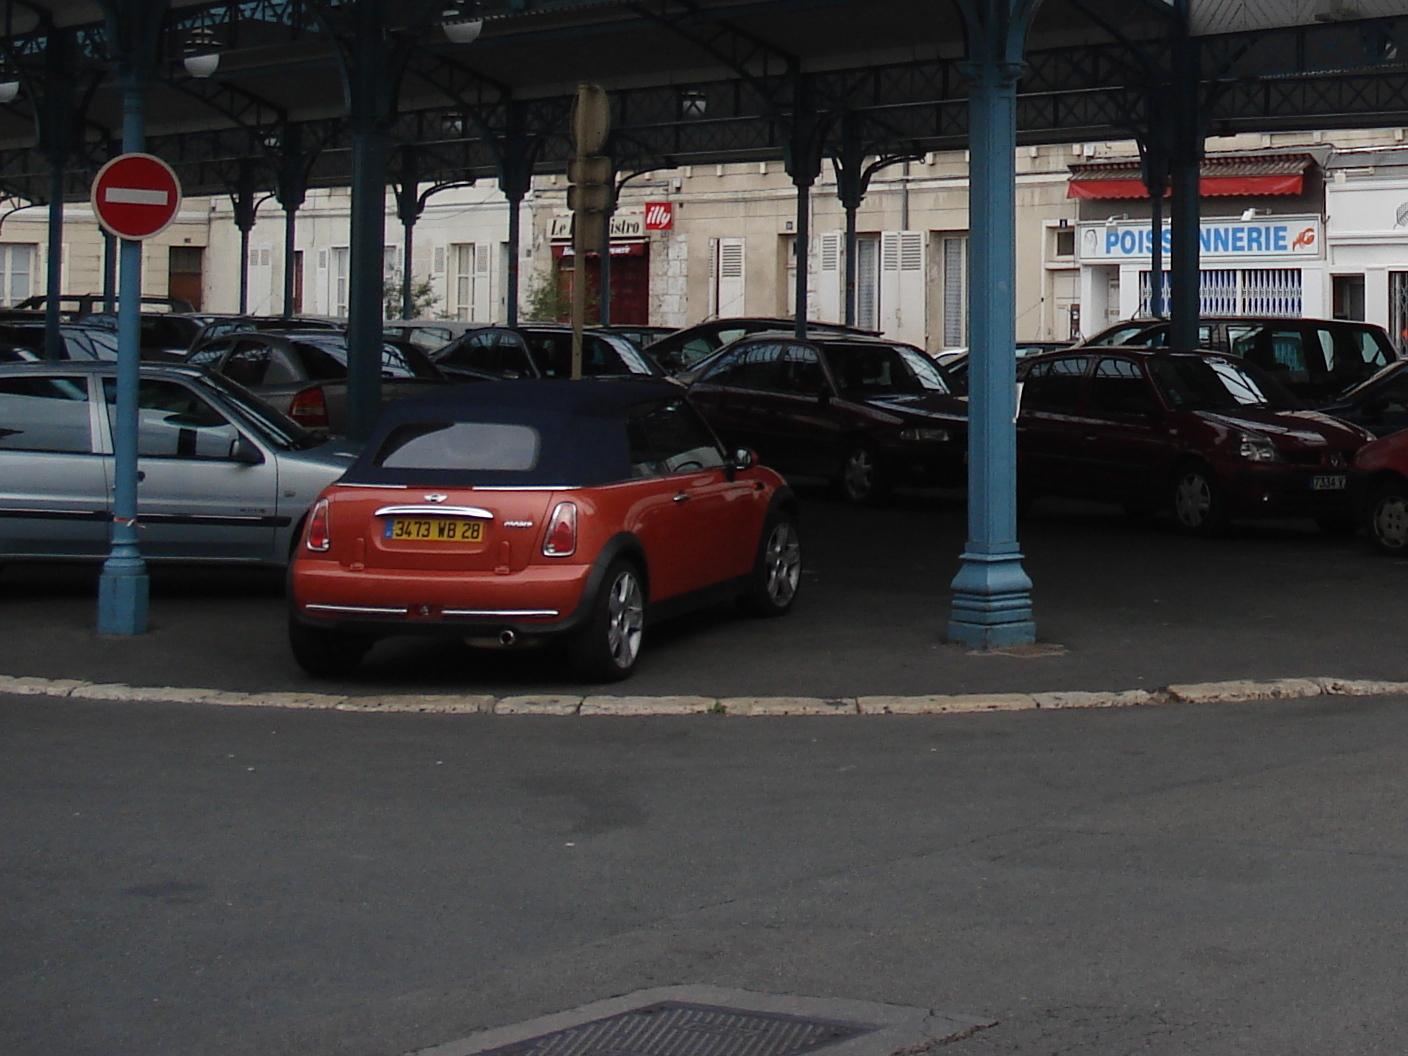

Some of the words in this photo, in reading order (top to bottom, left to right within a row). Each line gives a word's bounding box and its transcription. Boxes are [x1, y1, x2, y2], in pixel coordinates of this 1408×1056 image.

[550, 219, 566, 236] Le
[646, 205, 671, 229] illy
[1105, 226, 1288, 255] POISSNNERIE
[395, 521, 431, 538] 3473
[437, 523, 457, 539] WB
[461, 523, 481, 540] 28
